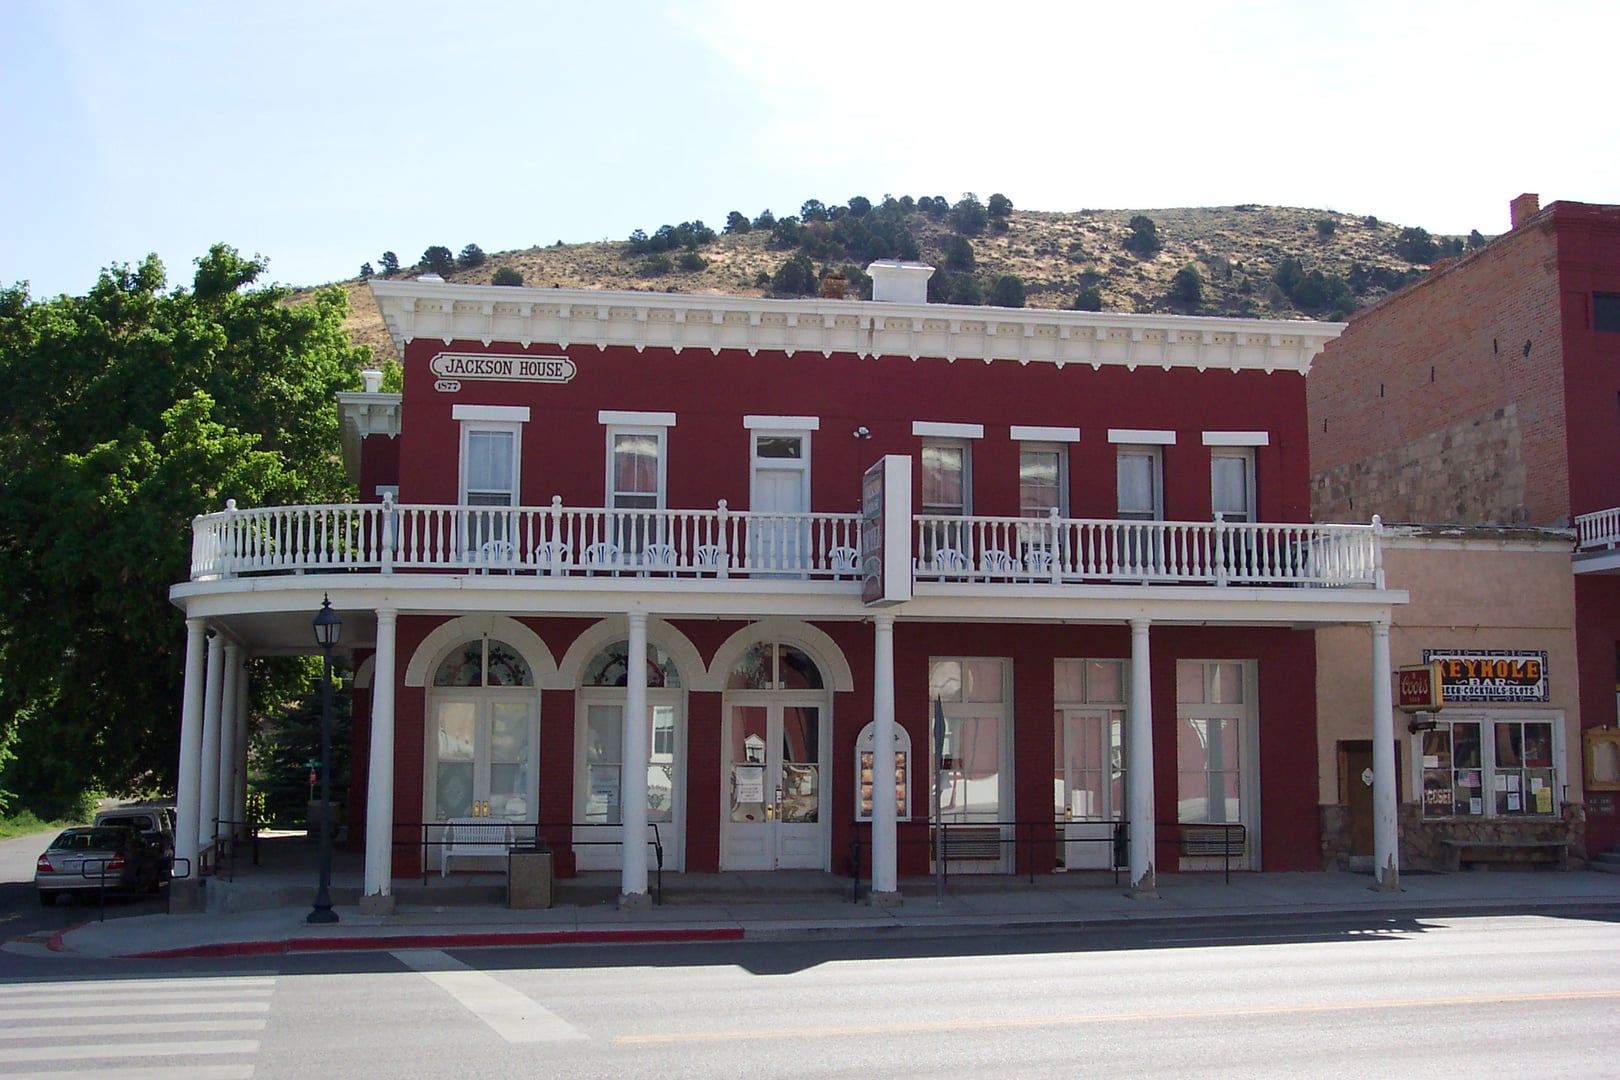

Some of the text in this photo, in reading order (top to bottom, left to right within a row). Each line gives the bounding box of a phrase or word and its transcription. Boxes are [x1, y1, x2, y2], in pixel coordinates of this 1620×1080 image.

[445, 358, 563, 377] JACKSON HOUSE
[437, 382, 459, 390] 1877
[1434, 659, 1540, 678] KEYHOLE
[1402, 675, 1428, 695] Coors
[1468, 678, 1506, 687] BAR
[1464, 686, 1506, 695] COCKTAILS
[1508, 687, 1535, 695] SLOTS
